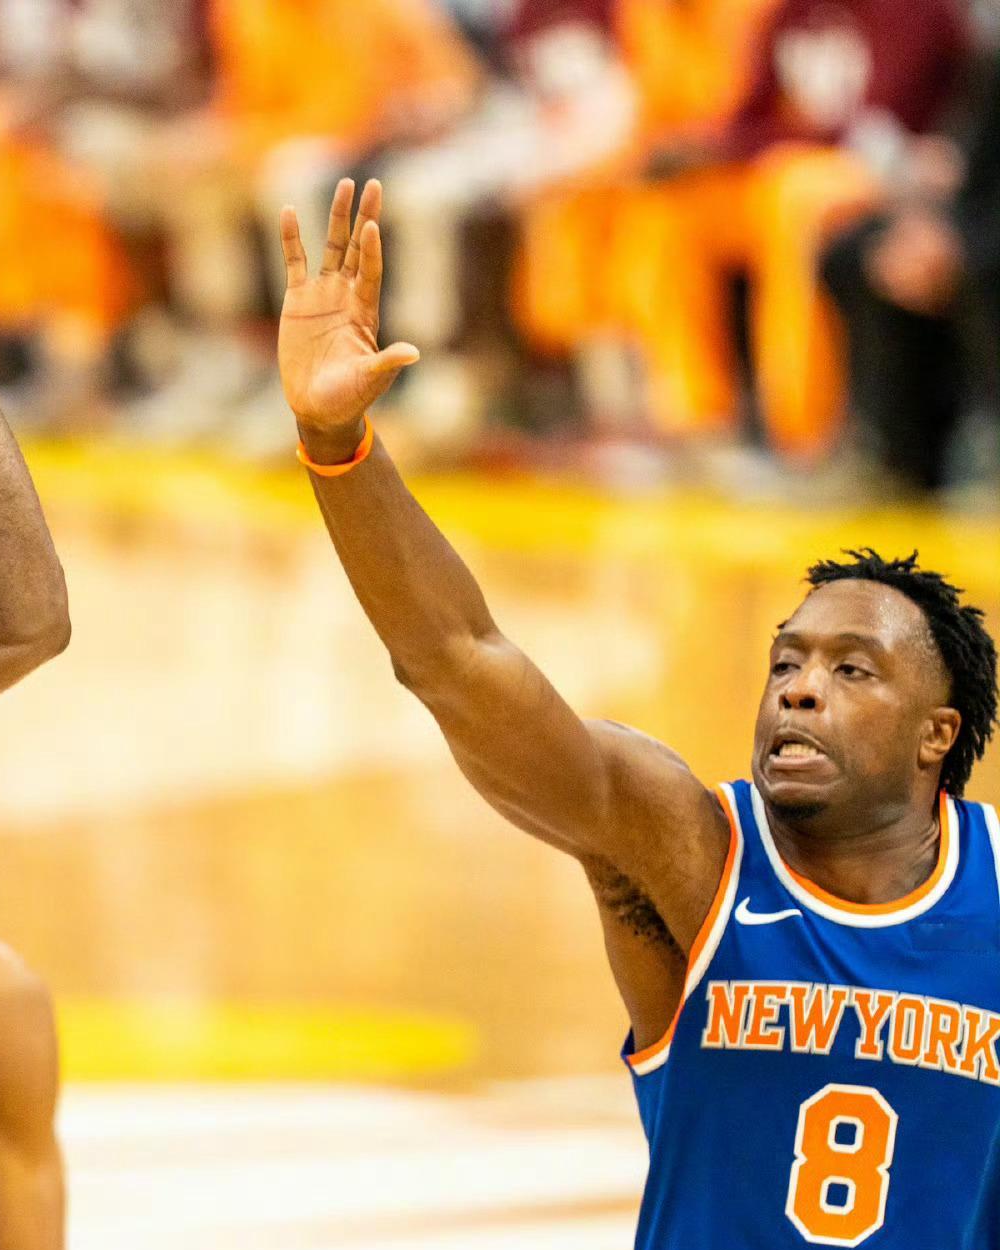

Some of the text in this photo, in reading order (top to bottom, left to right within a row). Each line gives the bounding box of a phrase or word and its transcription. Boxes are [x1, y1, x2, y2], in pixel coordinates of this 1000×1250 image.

[701, 980, 1000, 1087] NEW YORK
[785, 1083, 899, 1248] 8
